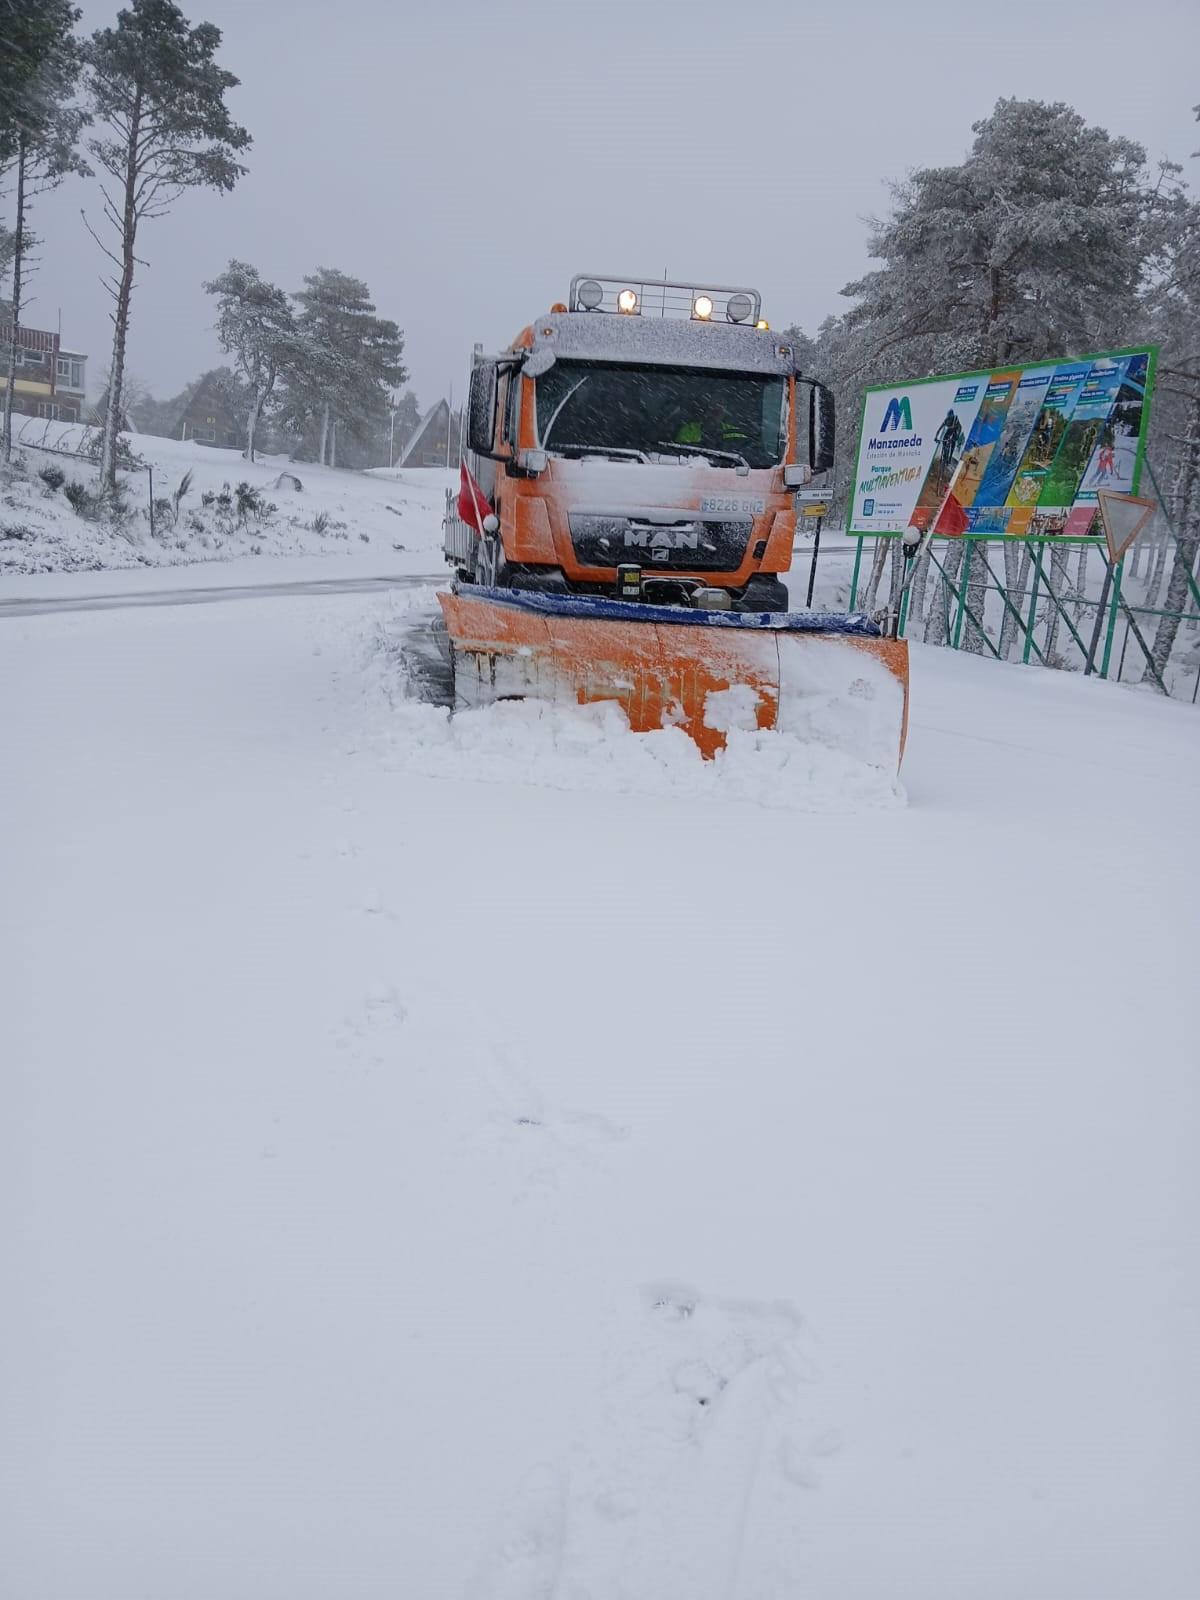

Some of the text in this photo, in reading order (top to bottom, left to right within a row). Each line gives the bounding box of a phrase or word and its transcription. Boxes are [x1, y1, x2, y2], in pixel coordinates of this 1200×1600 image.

[868, 433, 922, 450] Manzaneda
[871, 465, 892, 474] Parque
[859, 465, 922, 494] MULTIAVENTURA
[624, 530, 698, 549] MAN
